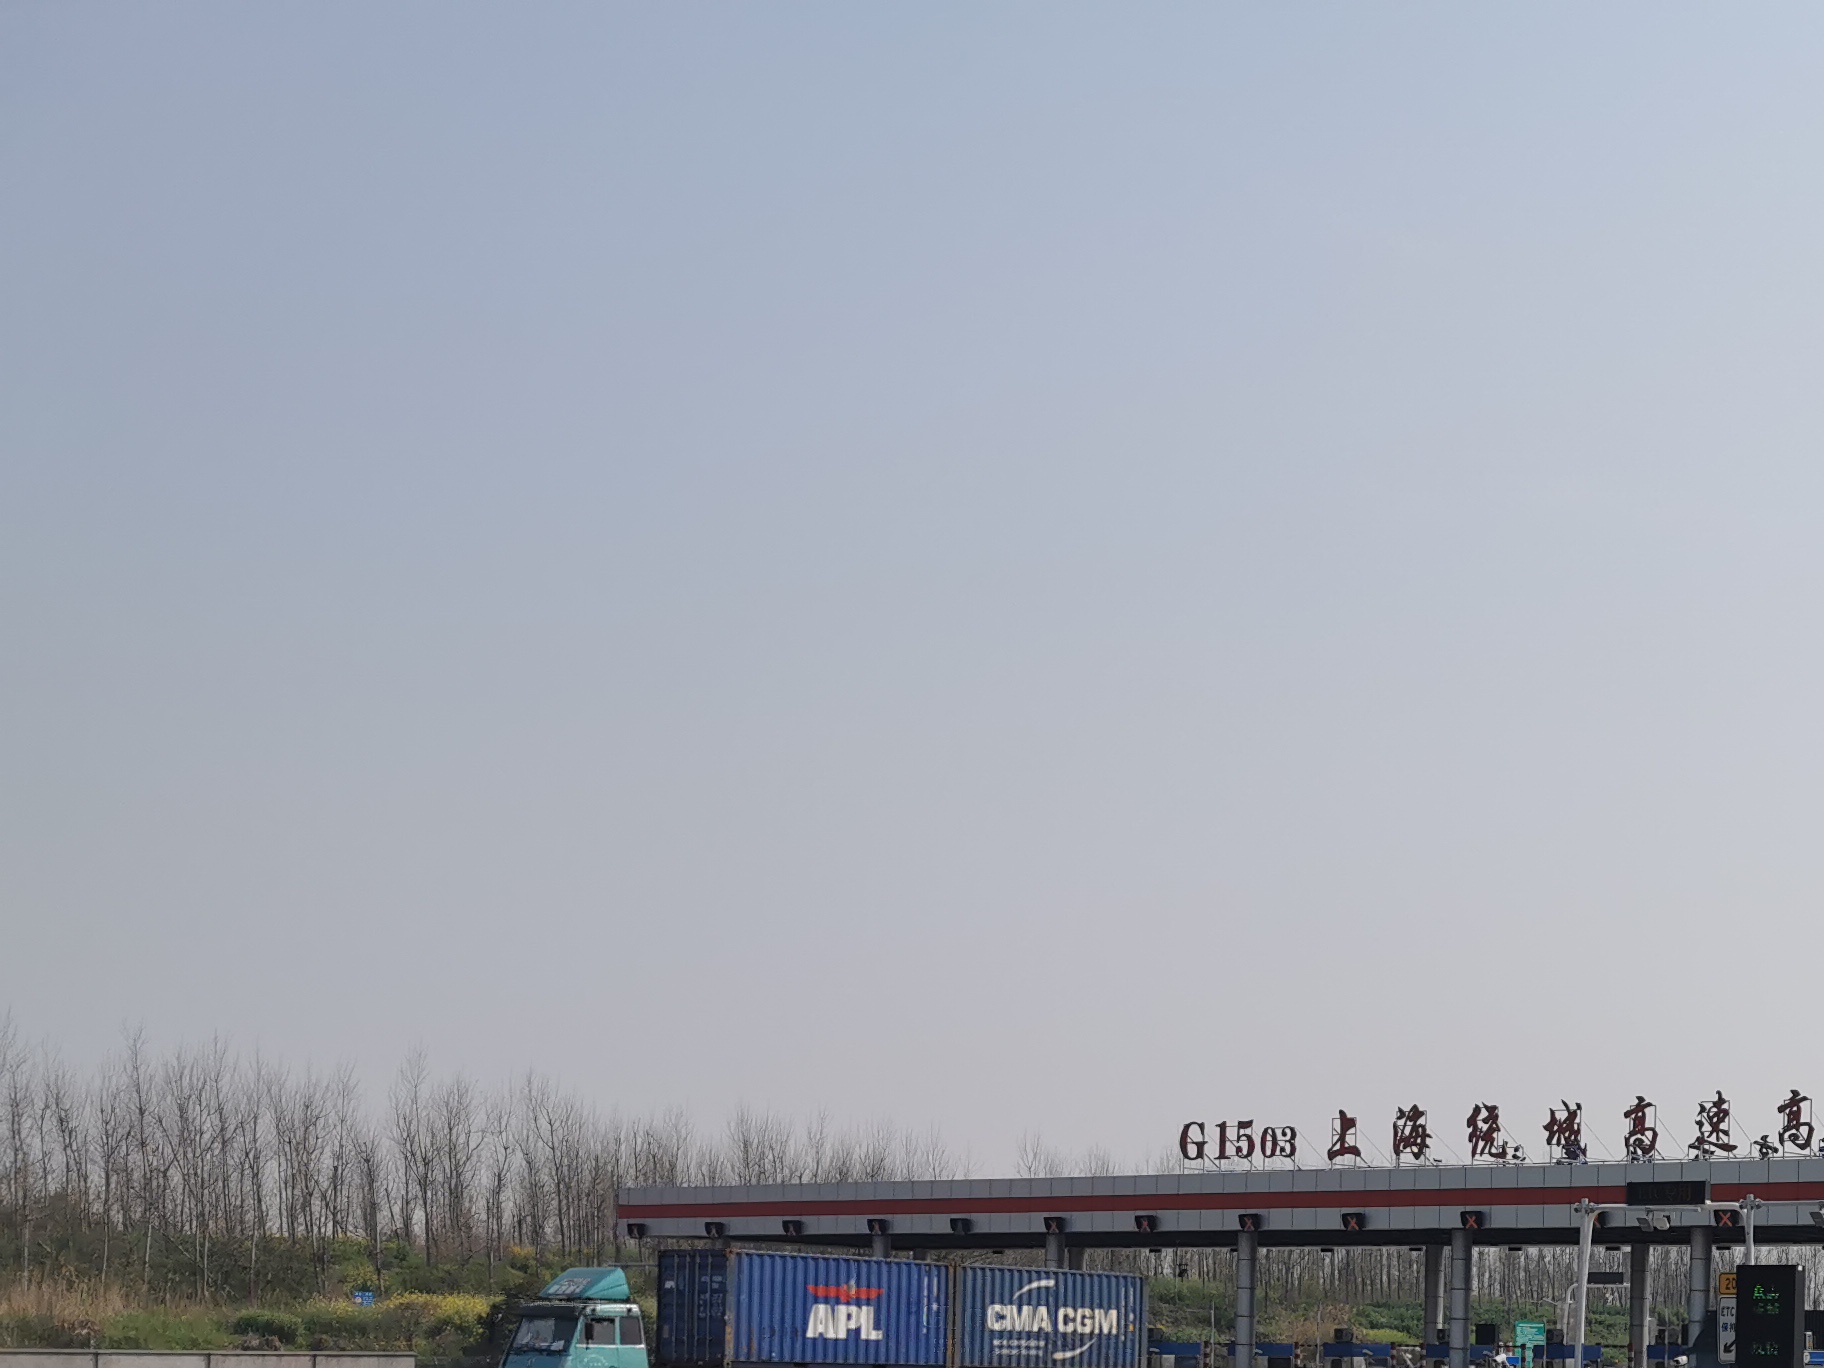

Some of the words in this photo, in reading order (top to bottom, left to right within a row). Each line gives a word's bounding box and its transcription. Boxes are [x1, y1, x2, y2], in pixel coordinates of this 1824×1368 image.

[1180, 1119, 1297, 1160] G1503
[806, 1303, 883, 1340] APL
[987, 1304, 1051, 1333] CMA
[1057, 1306, 1118, 1335] CGM
